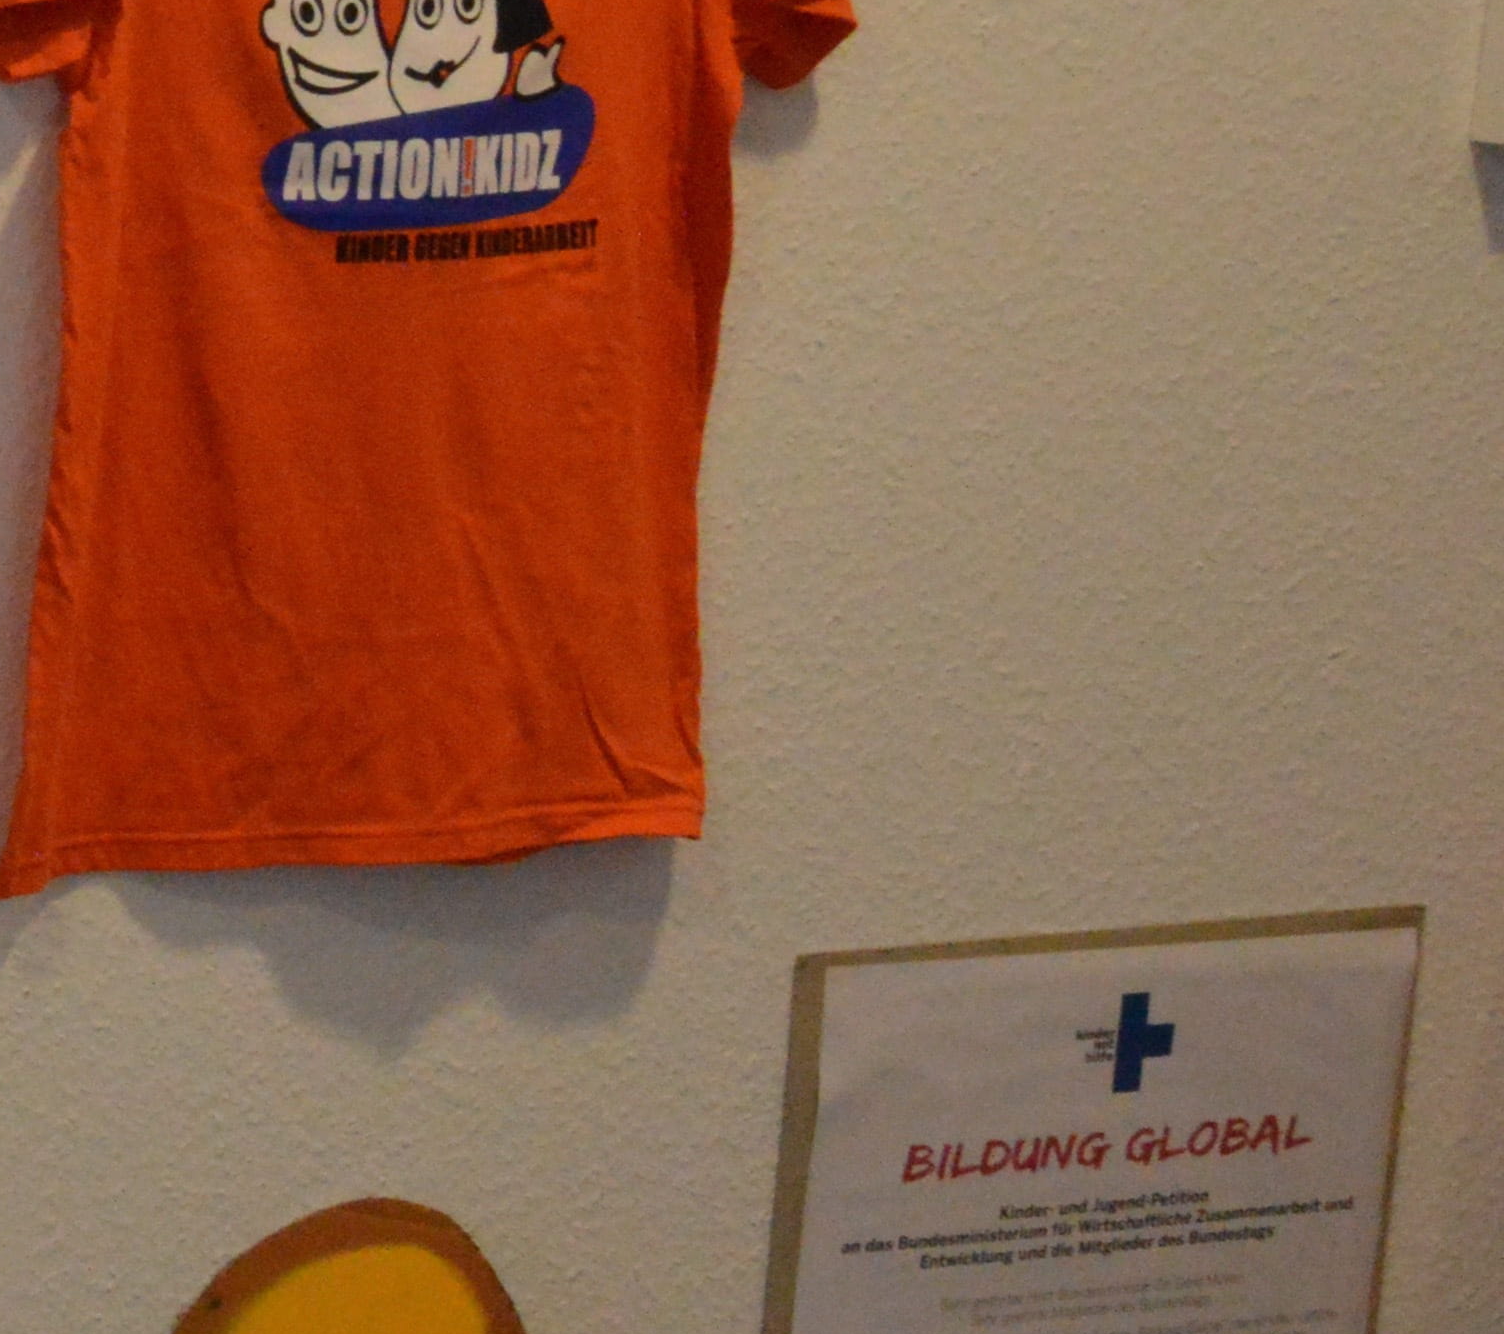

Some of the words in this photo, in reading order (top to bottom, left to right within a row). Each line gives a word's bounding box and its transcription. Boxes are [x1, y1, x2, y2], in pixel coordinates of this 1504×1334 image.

[335, 233, 410, 264] KINDER
[413, 230, 472, 263] GEGEN
[475, 217, 599, 259] KINDERARBEIT
[901, 1131, 1111, 1184] BILDUNG
[1124, 1113, 1313, 1165] GLOBAL
[841, 1242, 861, 1254] an
[864, 1238, 893, 1252] das
[897, 1225, 1048, 1250] Bundesministerium
[1051, 1222, 1073, 1237] für
[1195, 1198, 1321, 1224] Zusammenarbeit
[1324, 1195, 1354, 1212] und
[1057, 1200, 1088, 1215] und
[919, 1249, 1014, 1270] Entwicklung
[1017, 1245, 1047, 1260] und
[1051, 1242, 1074, 1257] die
[1078, 1236, 1155, 1256] Mitglieder
[1157, 1233, 1184, 1248] des
[1188, 1225, 1276, 1245] Bundestags
